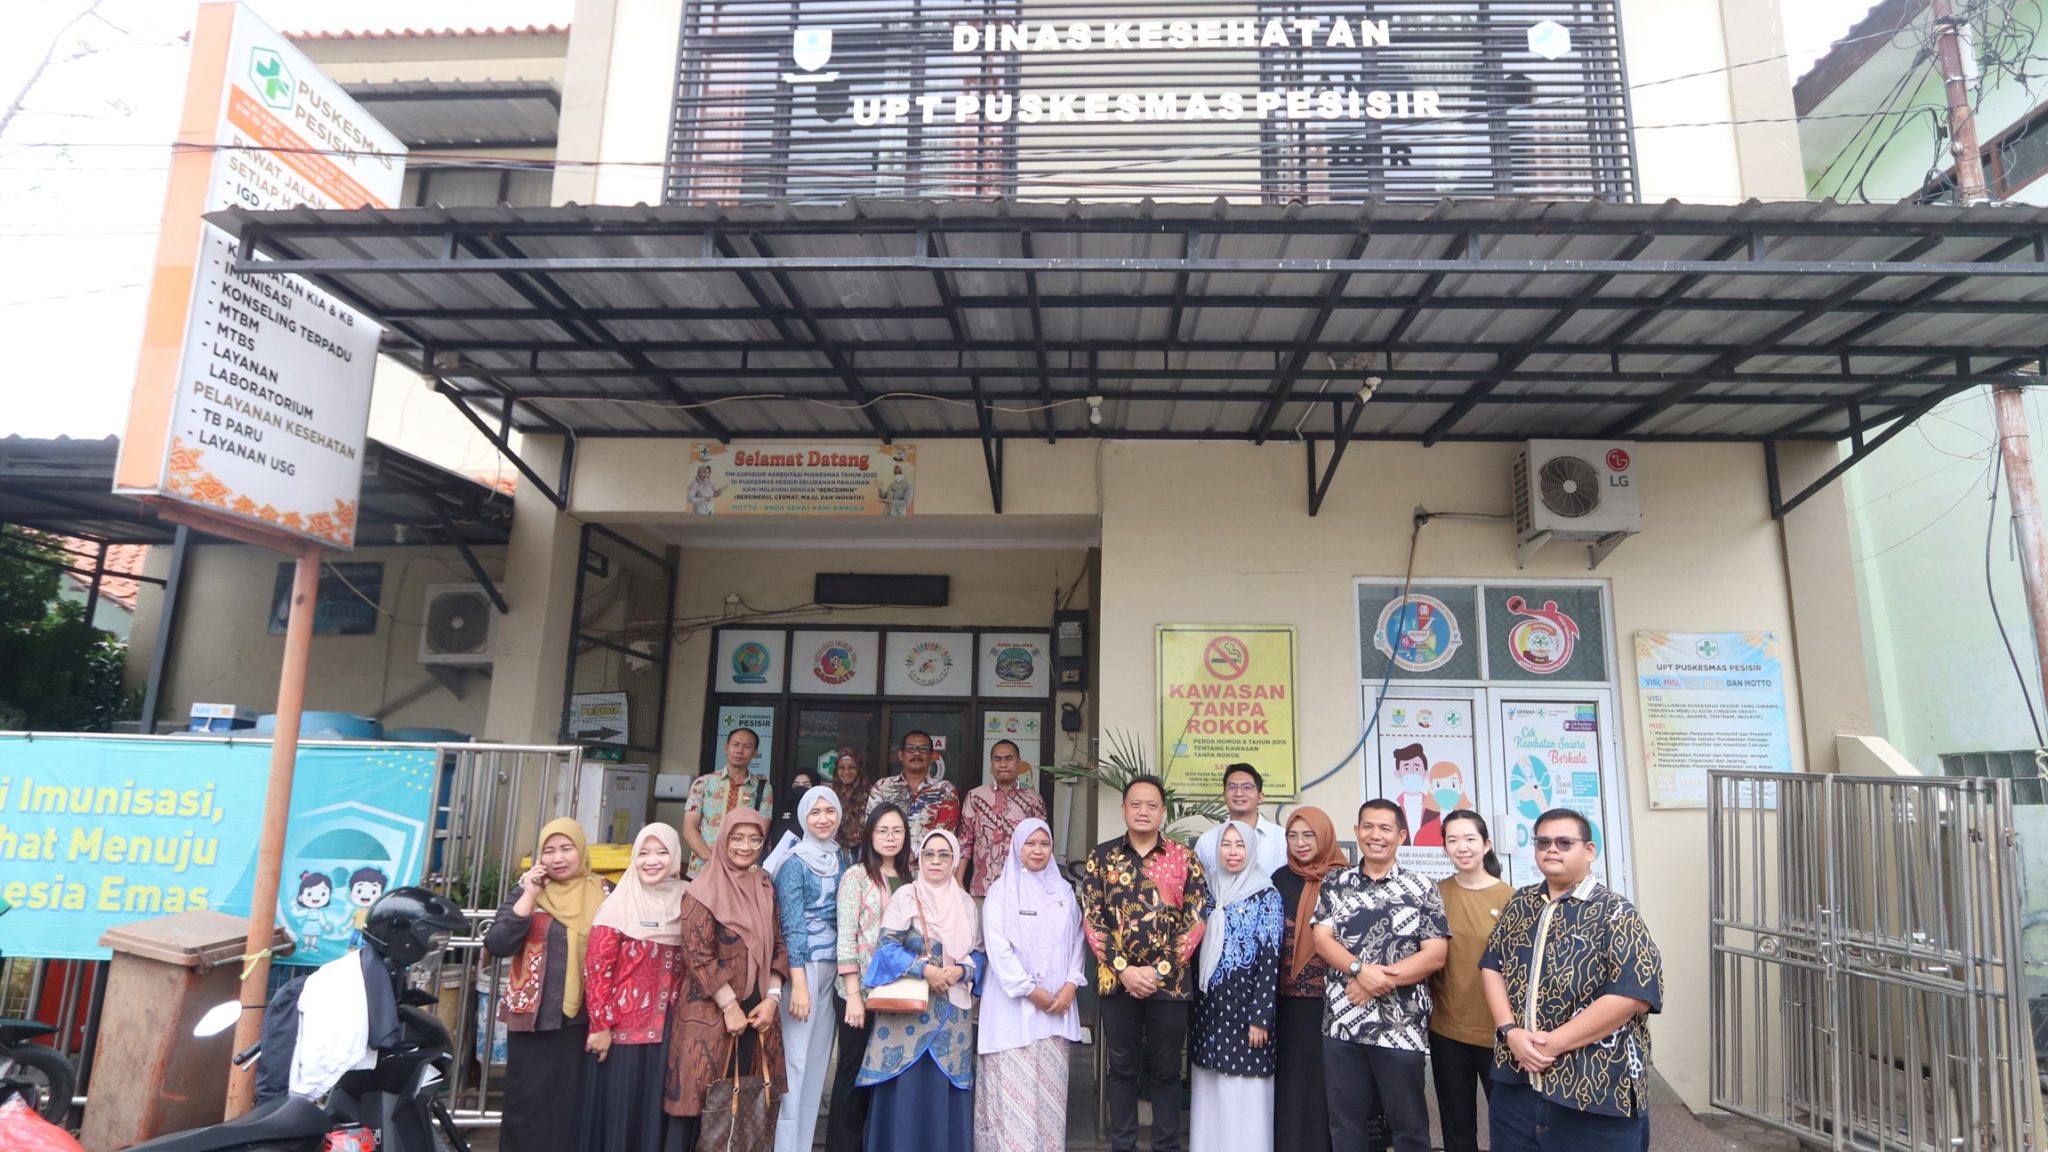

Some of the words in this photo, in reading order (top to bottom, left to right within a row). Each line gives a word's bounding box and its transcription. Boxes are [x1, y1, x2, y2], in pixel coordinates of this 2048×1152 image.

[953, 23, 1092, 52] DINAS
[1104, 19, 1390, 49] KESEHATAN
[298, 79, 393, 171] PUSKESMAS
[852, 95, 942, 126] UPT
[954, 92, 1244, 124] PUSKESMAS
[1256, 90, 1441, 120] PESISIR
[295, 103, 357, 167] PESISIR
[229, 156, 279, 198] SETIAP
[232, 134, 282, 179] RAWAT
[284, 177, 327, 210] JALAN
[236, 183, 260, 207] IGD
[224, 261, 292, 311] IMUNISASI
[218, 301, 260, 333] MTBM
[222, 281, 297, 333] KONSELING
[300, 325, 352, 363] TERPADU
[306, 288, 326, 311] KIA
[328, 302, 337, 316] &
[338, 309, 354, 327] KB
[216, 322, 256, 352] MTBS
[213, 342, 279, 384] LAYANAN
[209, 363, 314, 421] LABORATORIUM
[193, 381, 282, 429] PELAYANAN
[285, 420, 356, 460] KESEHATAN
[203, 408, 222, 427] TB
[225, 418, 263, 443] PARU
[199, 429, 267, 466] LAYANAN
[270, 456, 296, 476] USG
[734, 451, 803, 467] Selamat
[807, 451, 870, 471] Datang
[1610, 475, 1630, 487] LG
[1645, 679, 1662, 687] VISI,
[1663, 679, 1681, 687] MISI,
[1726, 679, 1743, 687] DAN
[1675, 664, 1727, 672] PUSKESMAS
[1168, 683, 1285, 700] KAWASAN
[1186, 719, 1269, 735] ROKOK
[1189, 701, 1266, 718] TANPA
[1513, 736, 1557, 749] Kesehatan
[1558, 737, 1586, 750] Secara
[1521, 726, 1536, 738] Cek
[1548, 749, 1588, 765] Berkala
[18, 777, 225, 826] Imunisasi,
[0, 824, 58, 861] hat
[67, 826, 219, 873] Menuju
[97, 876, 210, 914] Emas
